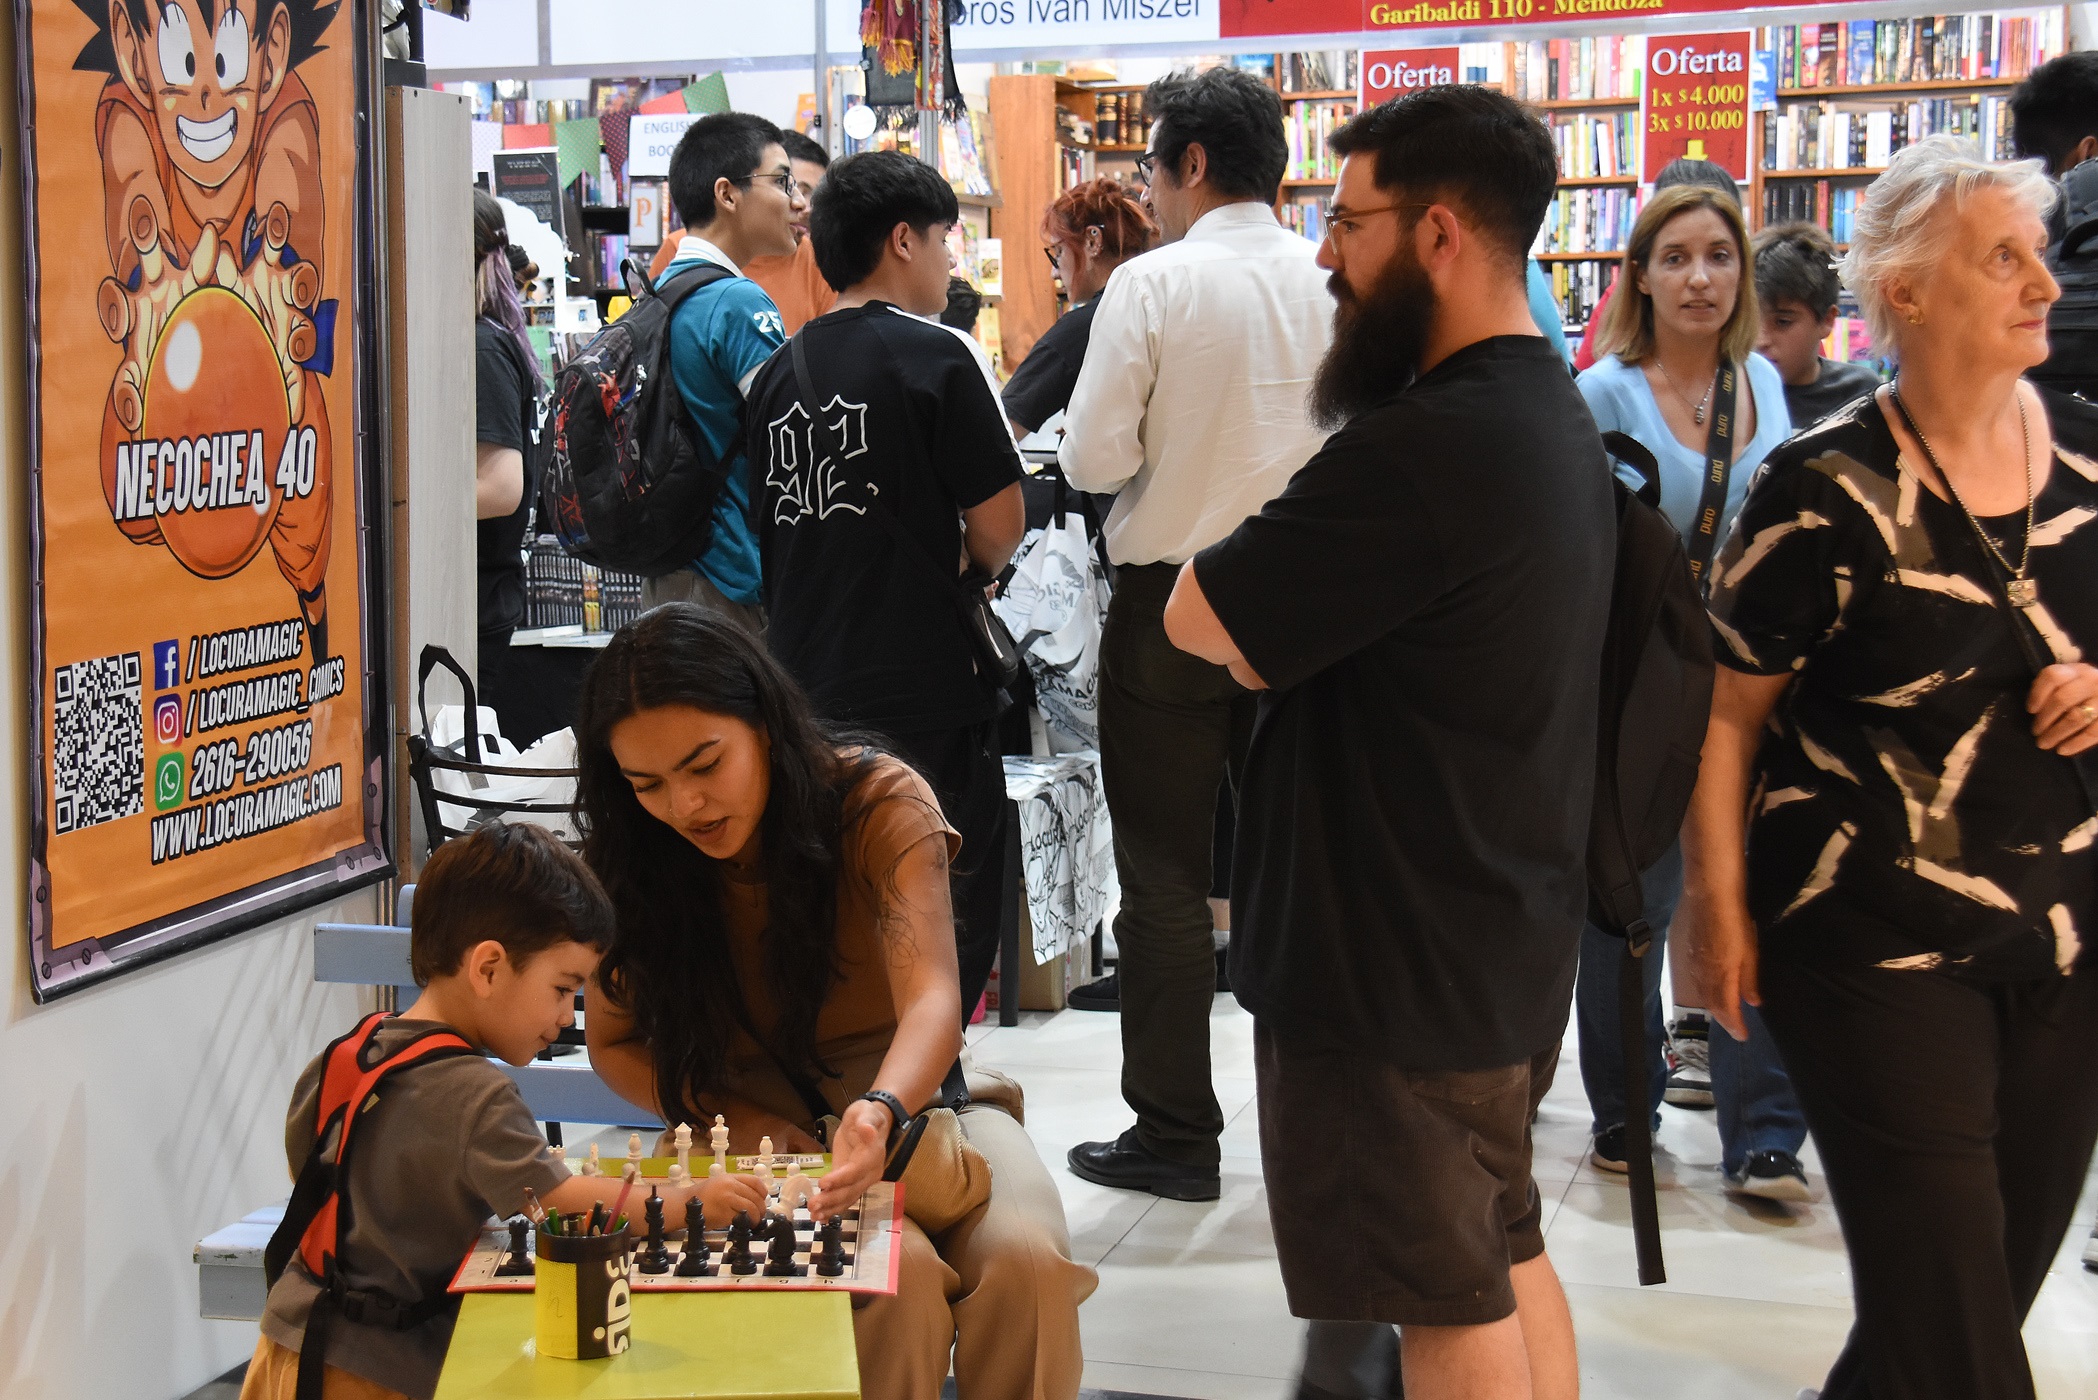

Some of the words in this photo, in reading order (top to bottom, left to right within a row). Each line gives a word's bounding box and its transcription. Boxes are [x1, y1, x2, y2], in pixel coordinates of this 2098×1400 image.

[1369, 2, 1482, 25] Garibaldi
[1489, 0, 1534, 18] 110
[1553, 0, 1664, 15] Mendoza
[1650, 46, 1743, 76] Oferta
[1367, 61, 1453, 90] Oferta
[1651, 87, 1674, 107] 1x
[1648, 113, 1671, 133] 3x
[753, 310, 783, 333] 25
[1716, 414, 1728, 438] puro
[115, 432, 264, 521] NECOCHEA
[275, 427, 317, 497] 40
[1711, 459, 1724, 484] puro
[1700, 508, 1716, 535] puro
[200, 621, 303, 675] LOCURAMAGIC
[199, 658, 345, 729] LOCURAMAGIC_COMICS
[191, 721, 313, 797] 2616-290056
[152, 766, 342, 862] WWW.LOCURAMAGIC.COM
